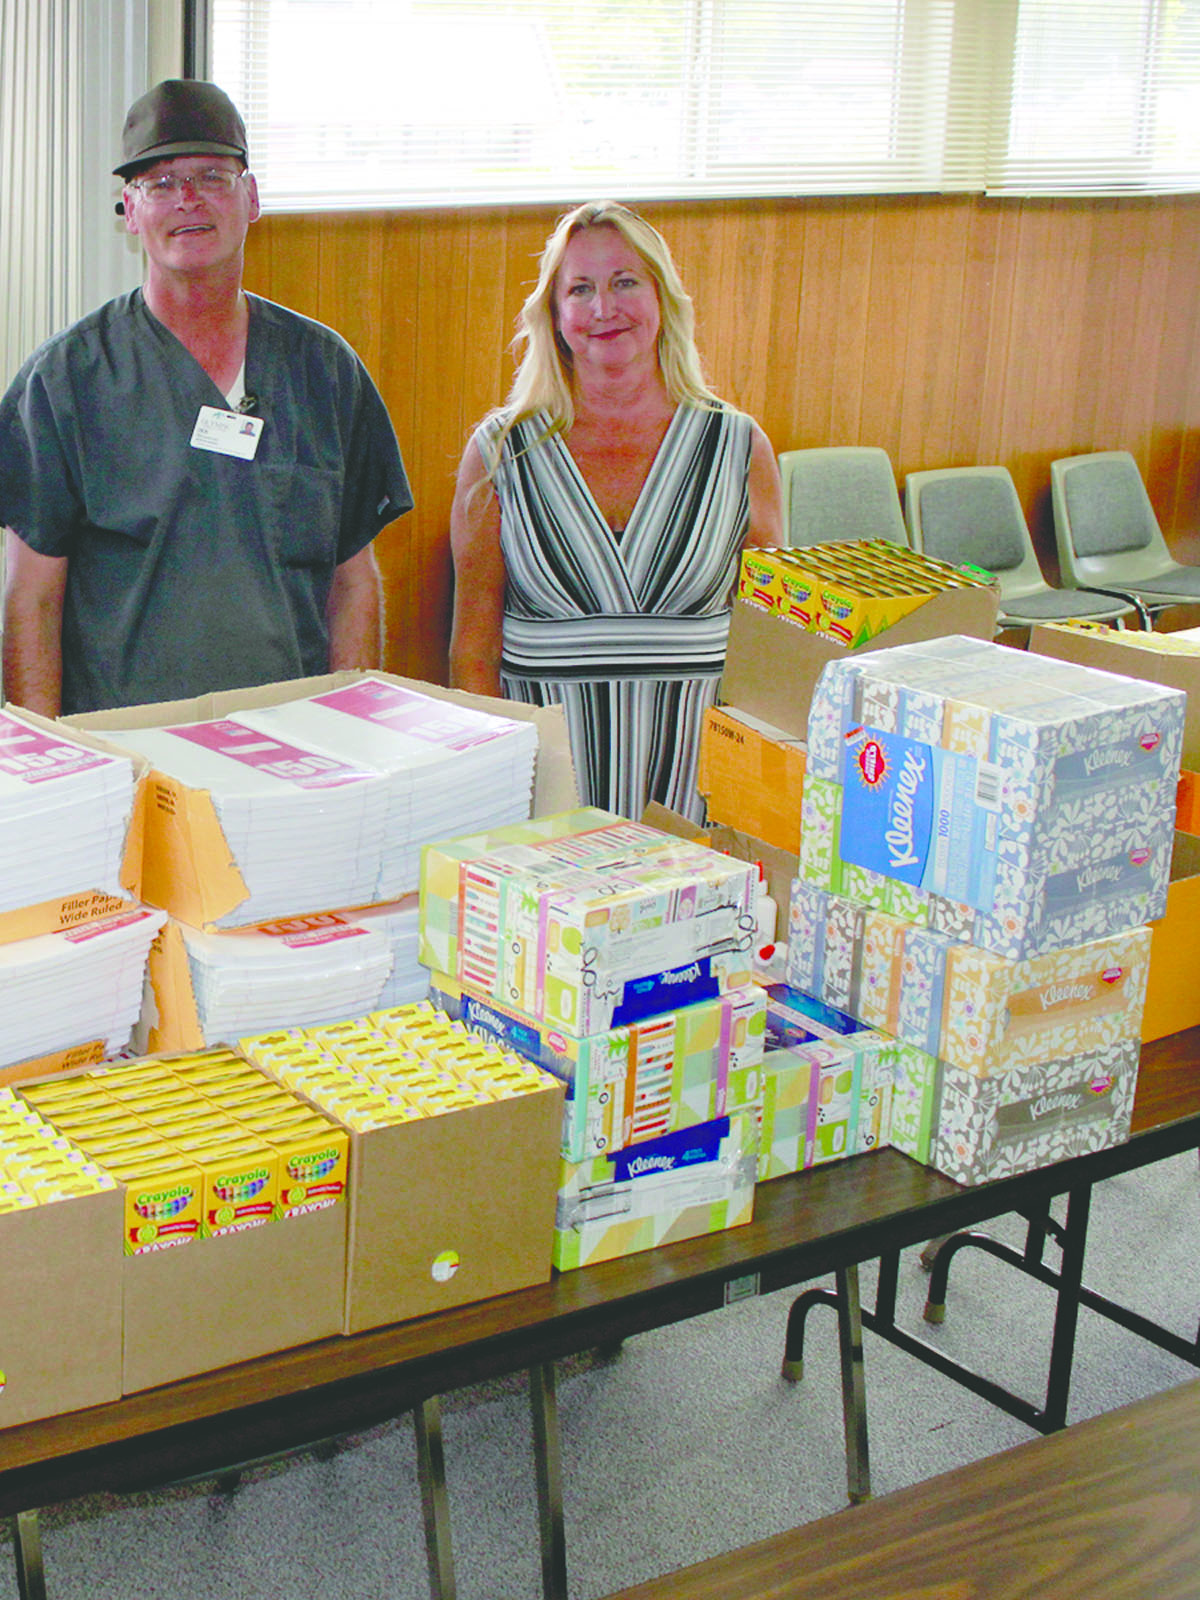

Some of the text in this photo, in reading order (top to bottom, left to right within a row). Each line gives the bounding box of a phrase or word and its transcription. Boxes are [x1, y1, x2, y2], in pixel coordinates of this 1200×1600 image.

[1084, 749, 1133, 776] Kleenex
[885, 750, 927, 868] Kleenex
[938, 809, 951, 839] 1000
[1077, 865, 1122, 893] Kleenex
[60, 900, 123, 924] Wide Ruled
[61, 898, 90, 913] Filler
[1040, 983, 1093, 1010] Kleenex
[1029, 1093, 1081, 1121] Kleenex
[288, 1148, 338, 1168] Crayola
[627, 1156, 676, 1178] Kleenex
[216, 1167, 268, 1189] Crayola
[137, 1185, 191, 1207] Crayola
